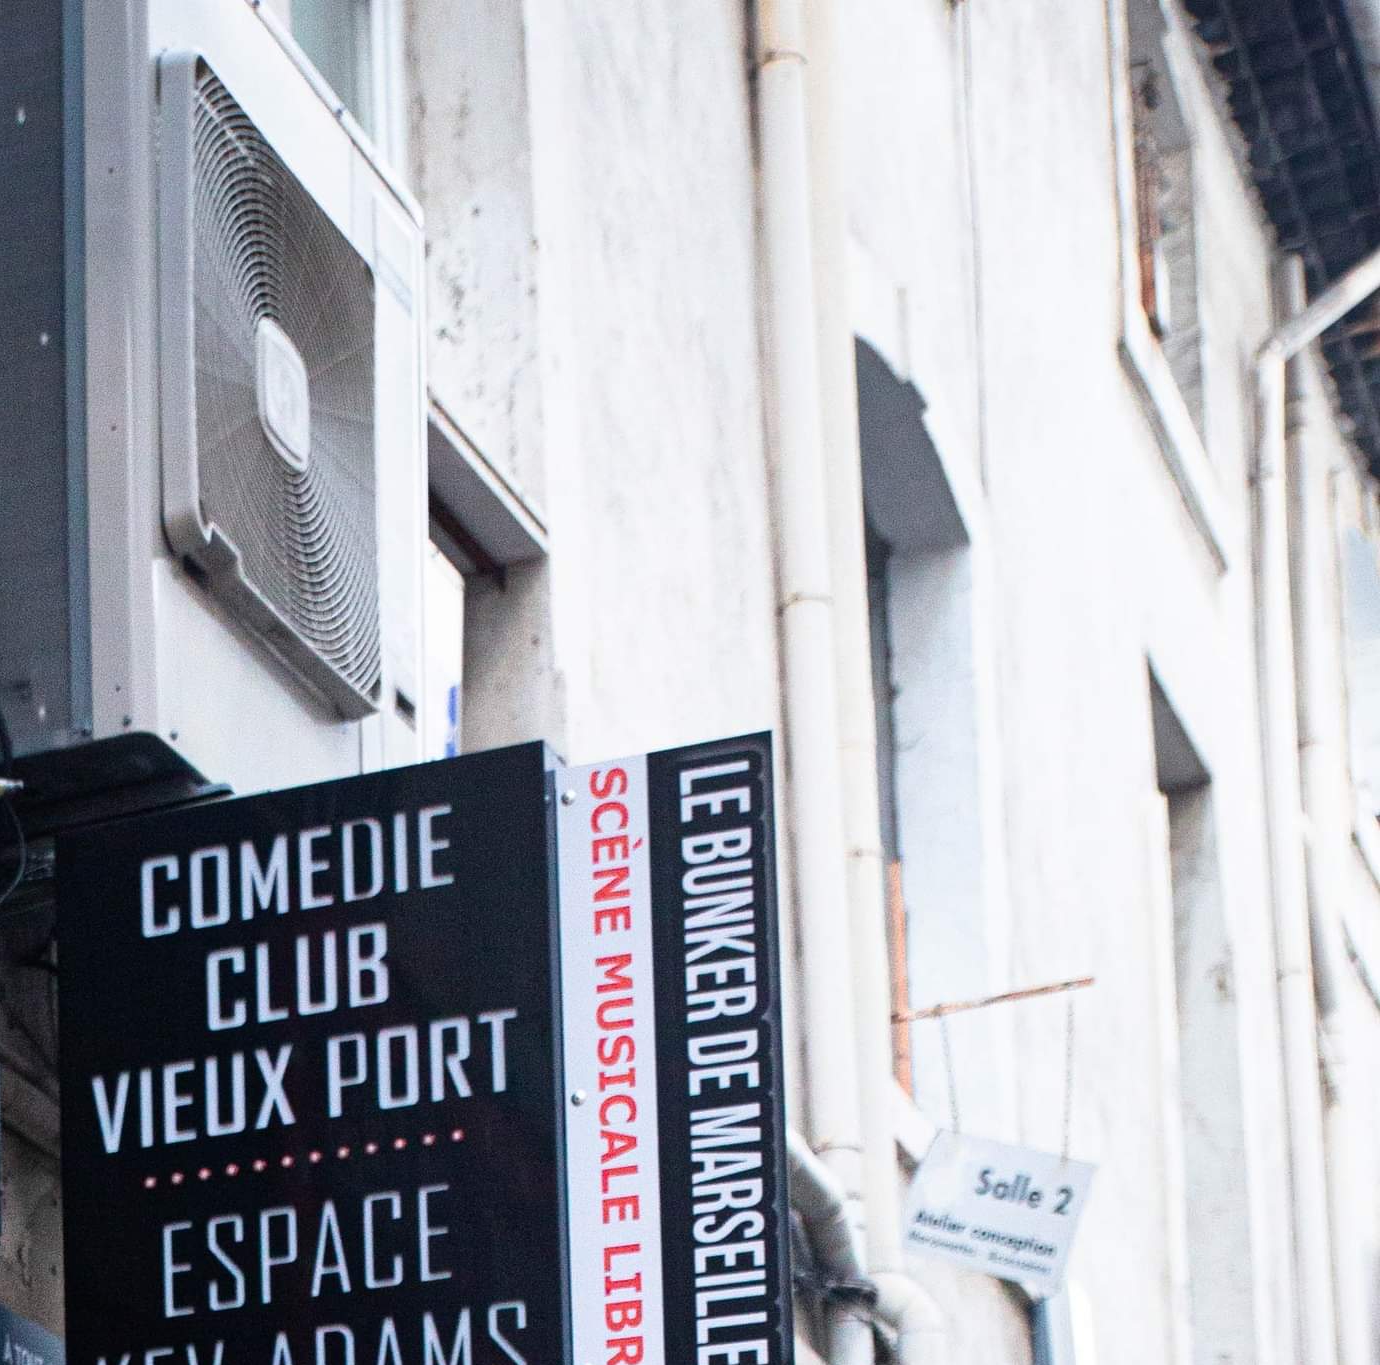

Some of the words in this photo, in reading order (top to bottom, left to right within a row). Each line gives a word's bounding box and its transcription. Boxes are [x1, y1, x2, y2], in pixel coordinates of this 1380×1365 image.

[588, 767, 644, 936] SCÈNE
[678, 760, 751, 826] LE
[140, 804, 454, 938] COMEDIE
[680, 829, 757, 1020] BUNKER
[206, 923, 390, 1031] CLUB
[91, 1042, 295, 1154] VIEUX
[327, 1009, 519, 1118] PORT
[595, 953, 640, 1226] MUSICALE
[687, 1028, 760, 1096] DE
[161, 1184, 452, 1319] ESPACE
[973, 1166, 1043, 1209] Salle
[1053, 1186, 1075, 1215] 2
